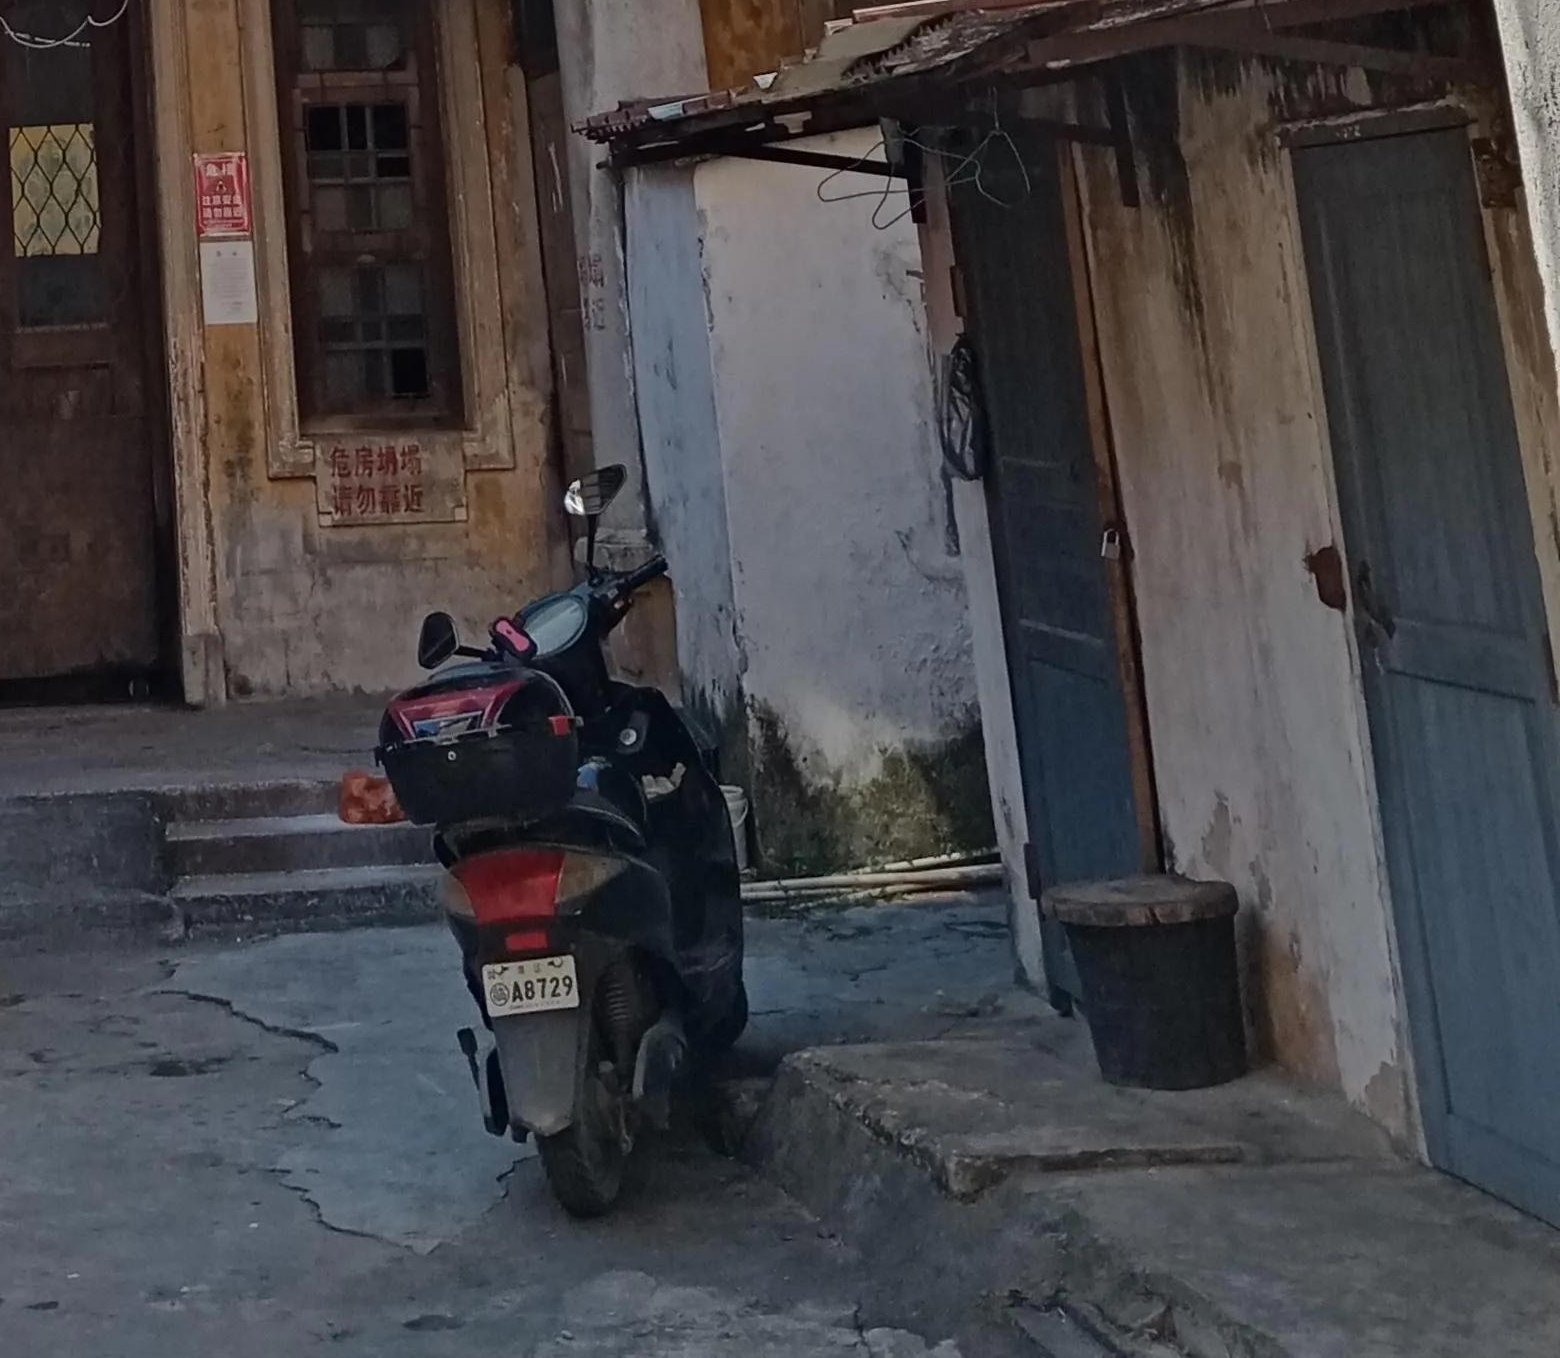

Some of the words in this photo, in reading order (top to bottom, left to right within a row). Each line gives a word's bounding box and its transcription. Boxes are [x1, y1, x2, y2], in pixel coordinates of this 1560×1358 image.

[329, 444, 423, 479] 危房坍塌
[332, 484, 425, 517] 请勿靠近
[511, 975, 573, 1003] A8729
